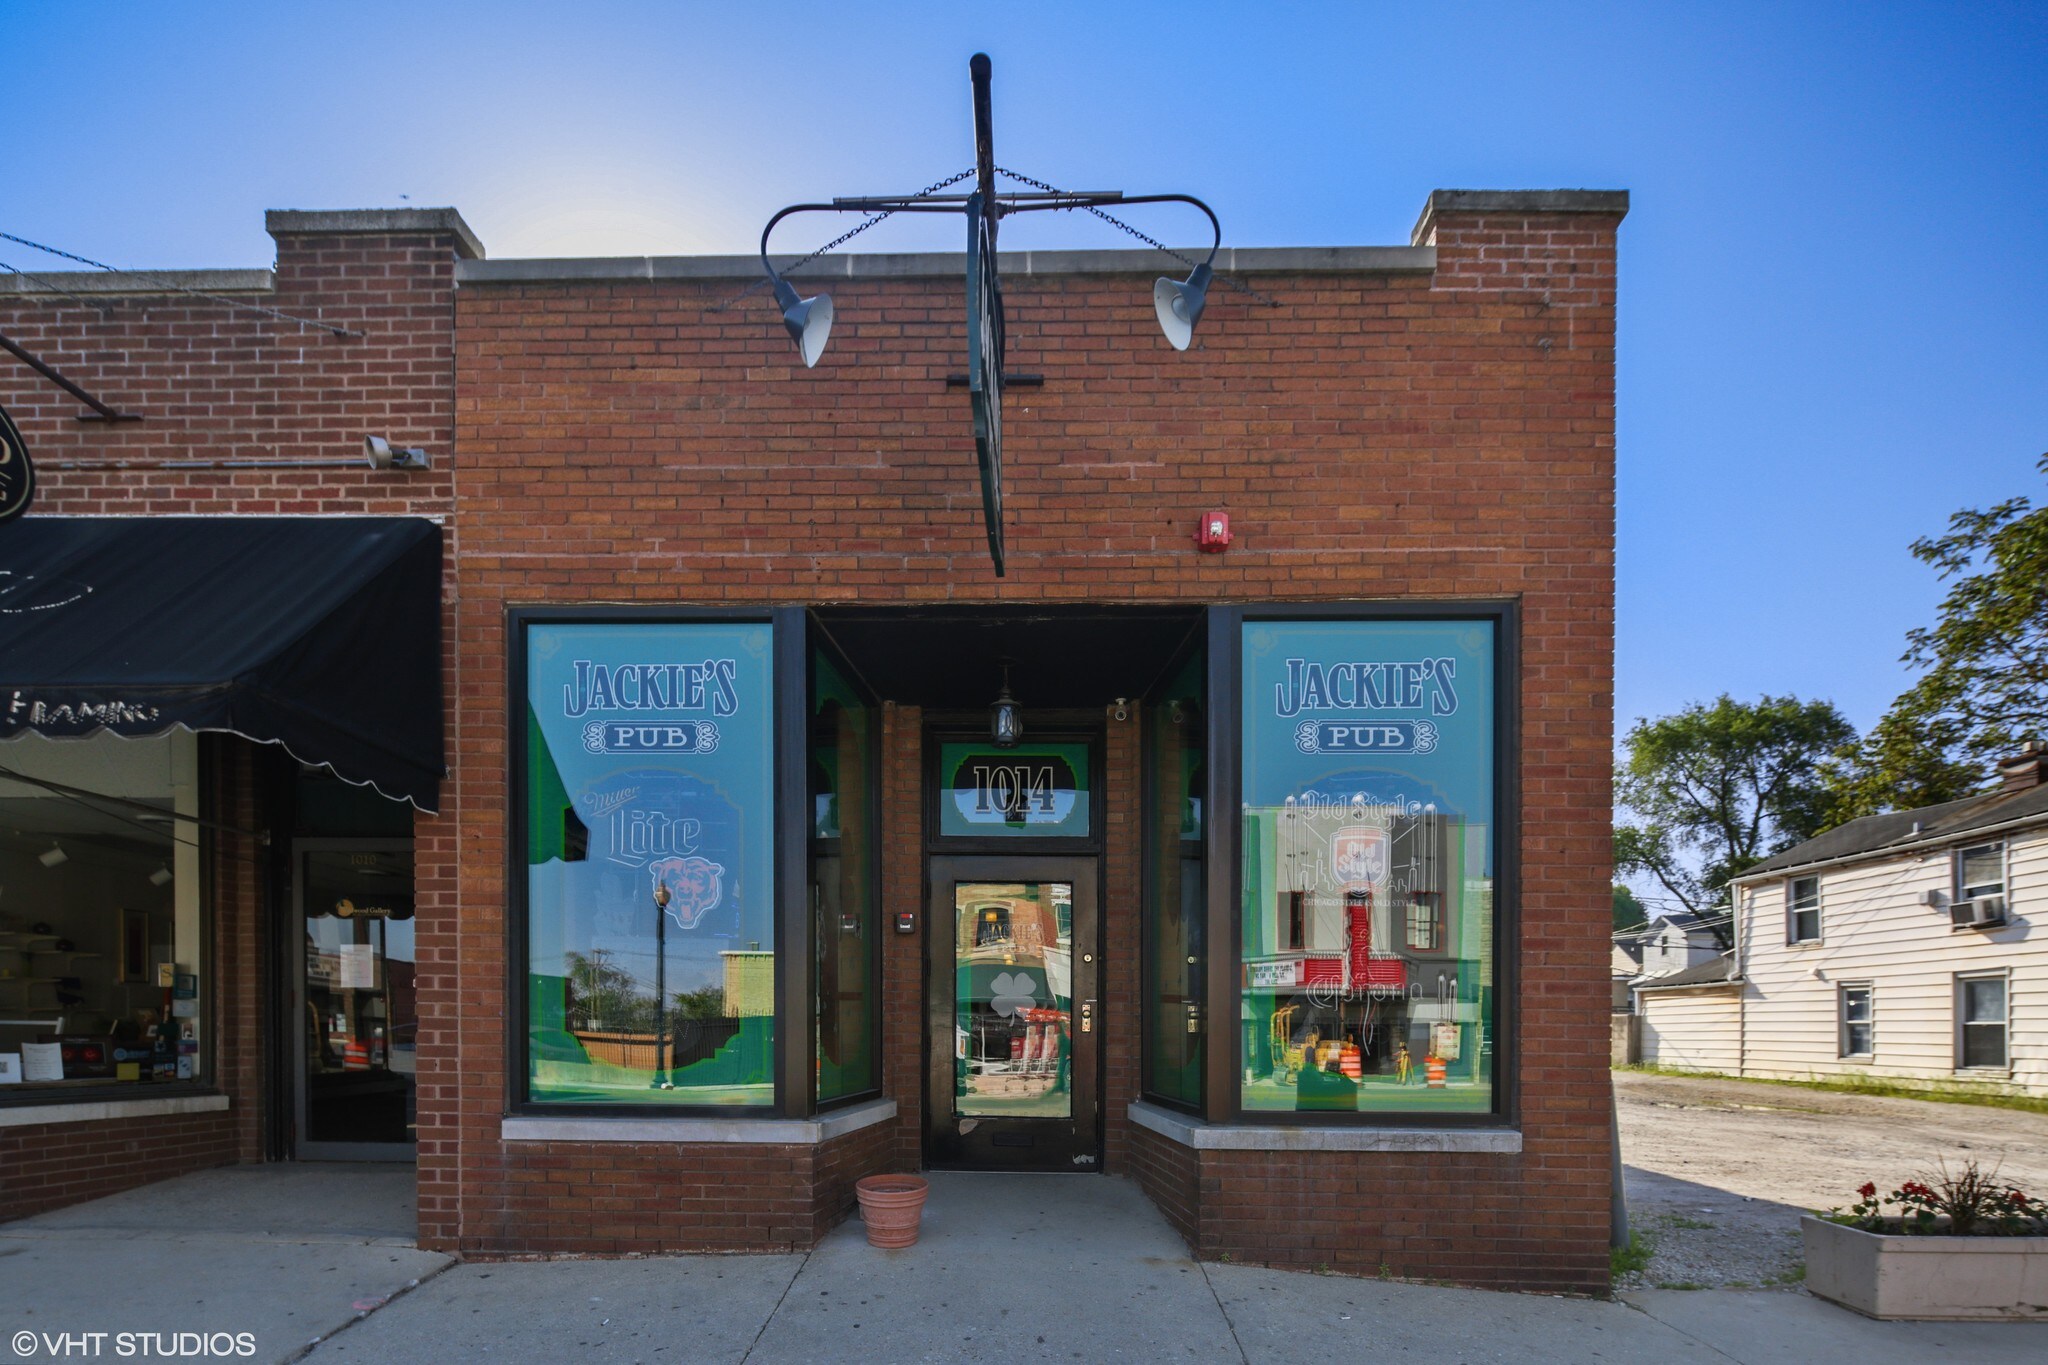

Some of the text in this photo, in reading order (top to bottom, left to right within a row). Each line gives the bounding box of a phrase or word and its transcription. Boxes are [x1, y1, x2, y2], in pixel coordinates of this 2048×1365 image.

[563, 658, 739, 718] JACKIE'S
[1275, 657, 1459, 718] JACKIE'S
[613, 727, 688, 747] PUB
[1328, 726, 1405, 747] PUB
[584, 785, 640, 811] Miller
[973, 765, 1056, 814] 1014
[607, 809, 701, 868] Lite
